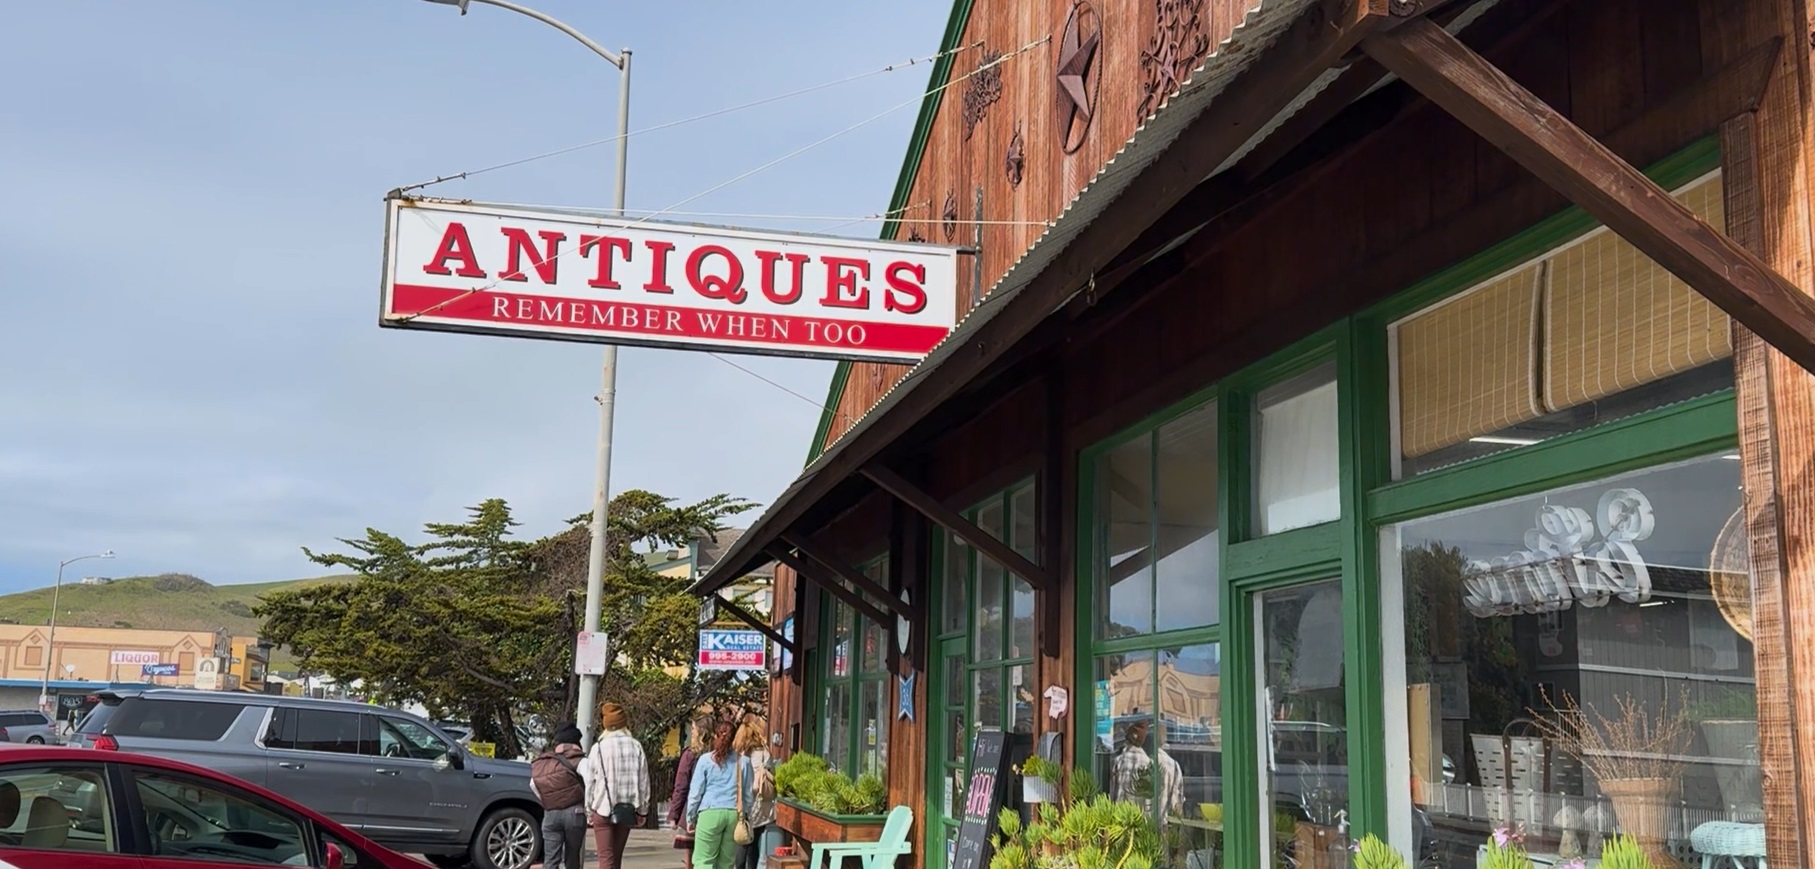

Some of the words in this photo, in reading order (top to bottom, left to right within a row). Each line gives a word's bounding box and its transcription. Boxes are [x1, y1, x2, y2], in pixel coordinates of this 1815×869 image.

[423, 222, 929, 315] ANTIQUES
[491, 296, 684, 332] REMEMBER
[697, 312, 791, 341] WHEN
[803, 321, 867, 346] TOO
[708, 633, 763, 650] KAISER
[708, 652, 757, 660] 995-2900
[114, 652, 158, 664] LIQUOR
[968, 774, 995, 817] OPEN
